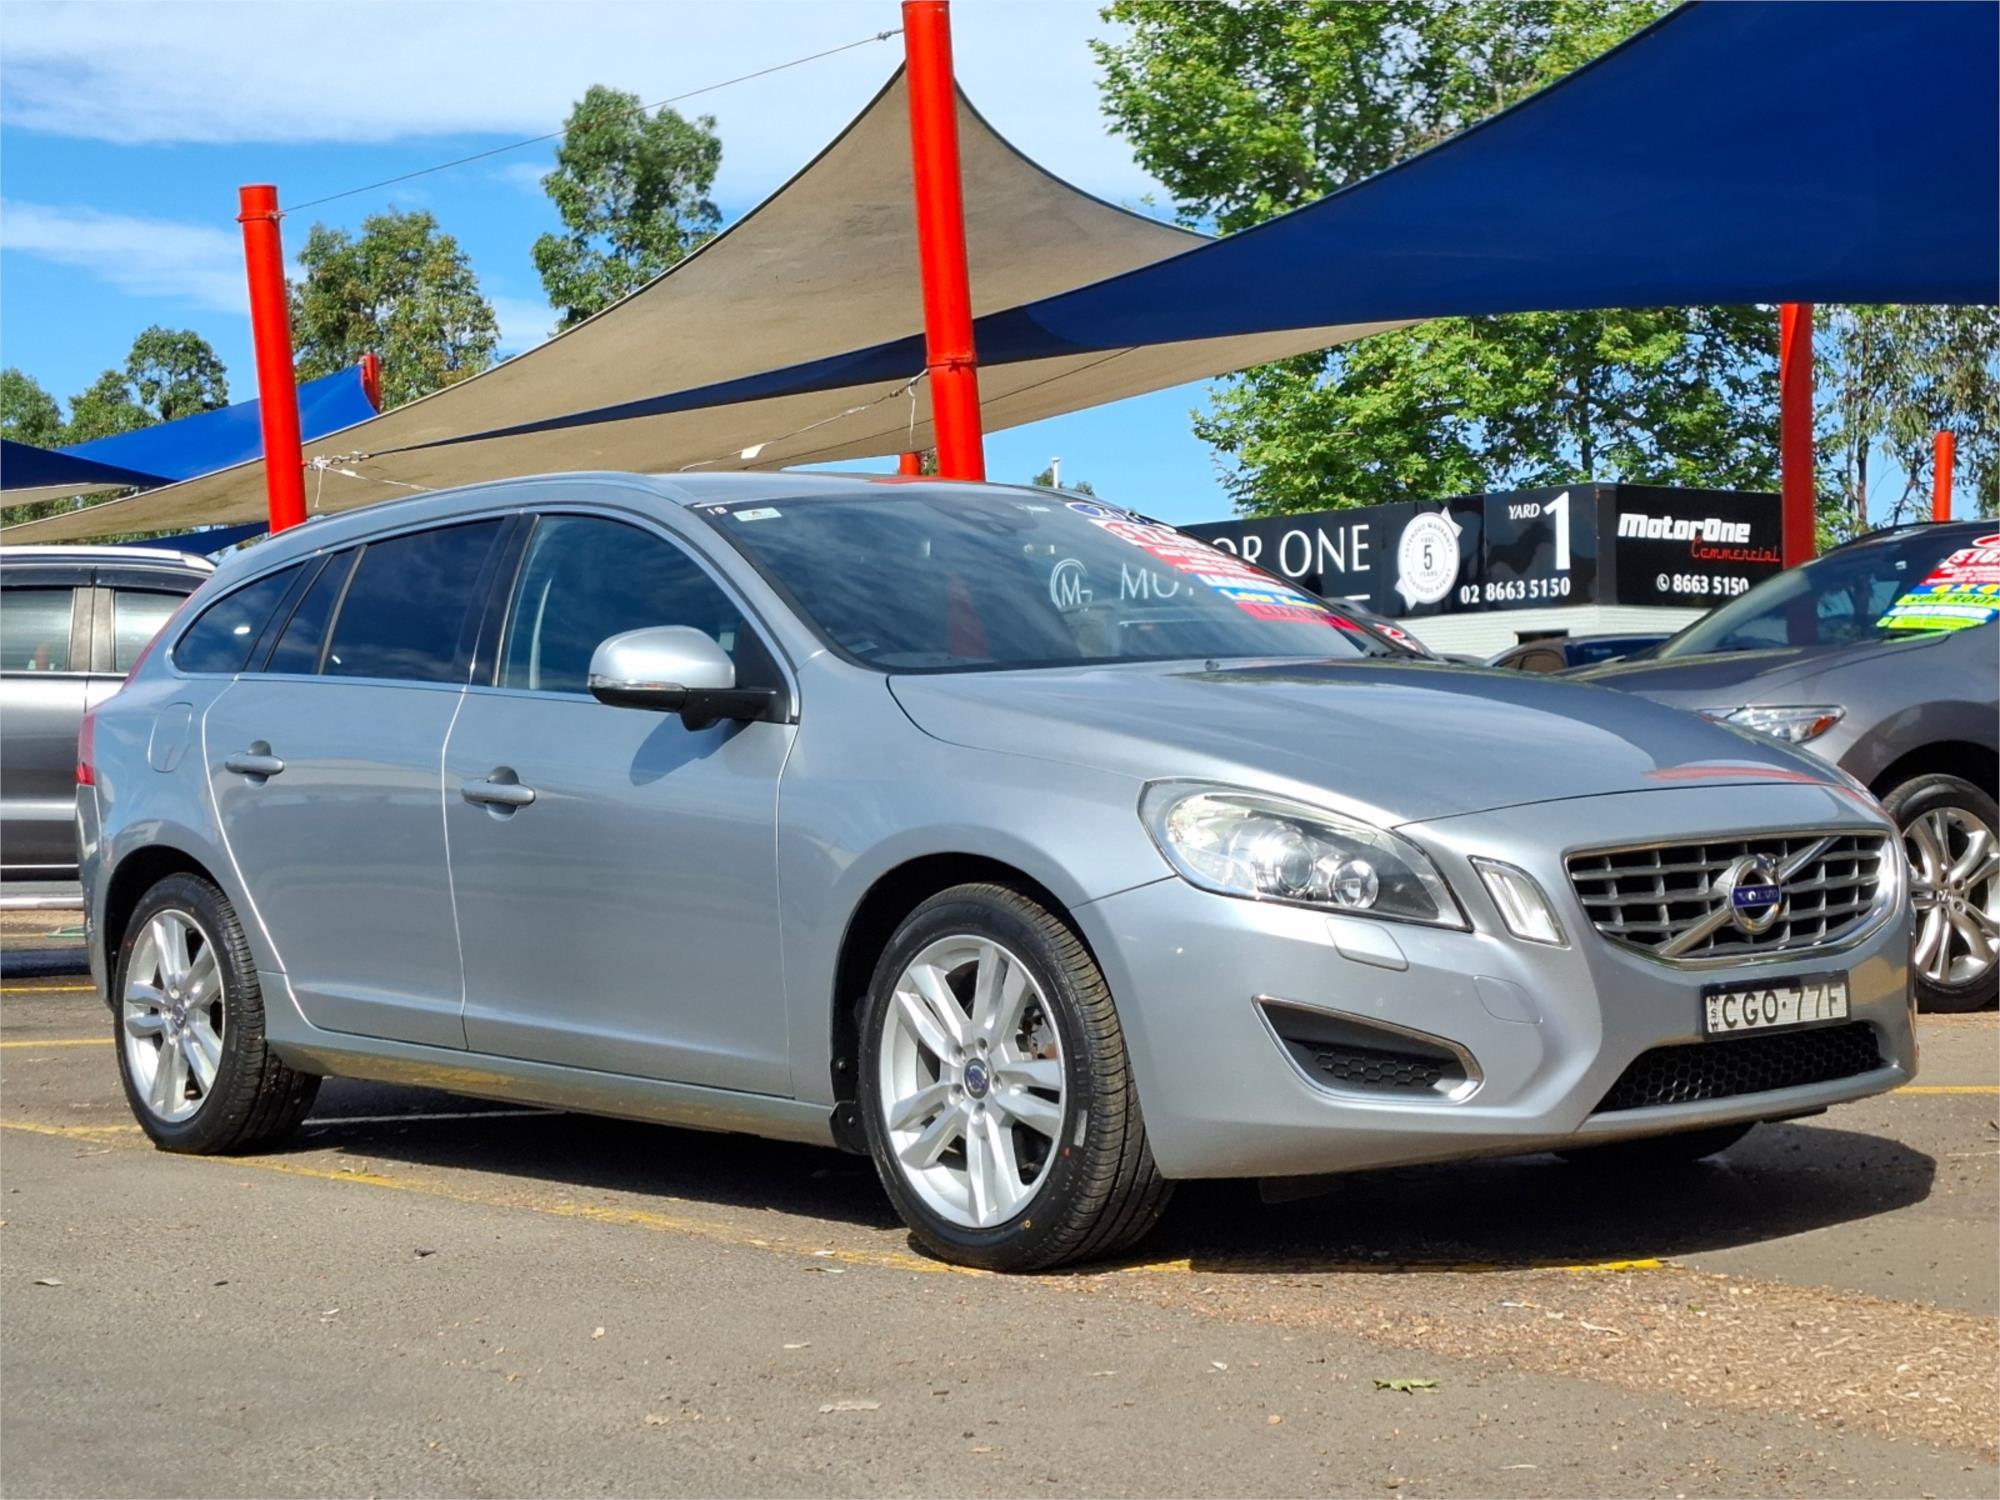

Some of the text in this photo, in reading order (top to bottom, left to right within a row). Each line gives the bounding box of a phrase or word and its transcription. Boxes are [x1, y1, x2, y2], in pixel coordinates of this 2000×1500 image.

[1508, 491, 1571, 570] YARD 1
[1279, 524, 1371, 578] ONE
[1423, 544, 1433, 570] 5
[1690, 535, 1781, 562] Commercial
[1460, 576, 1571, 604] 02 8663 5150
[1672, 573, 1749, 596] 8663 5150
